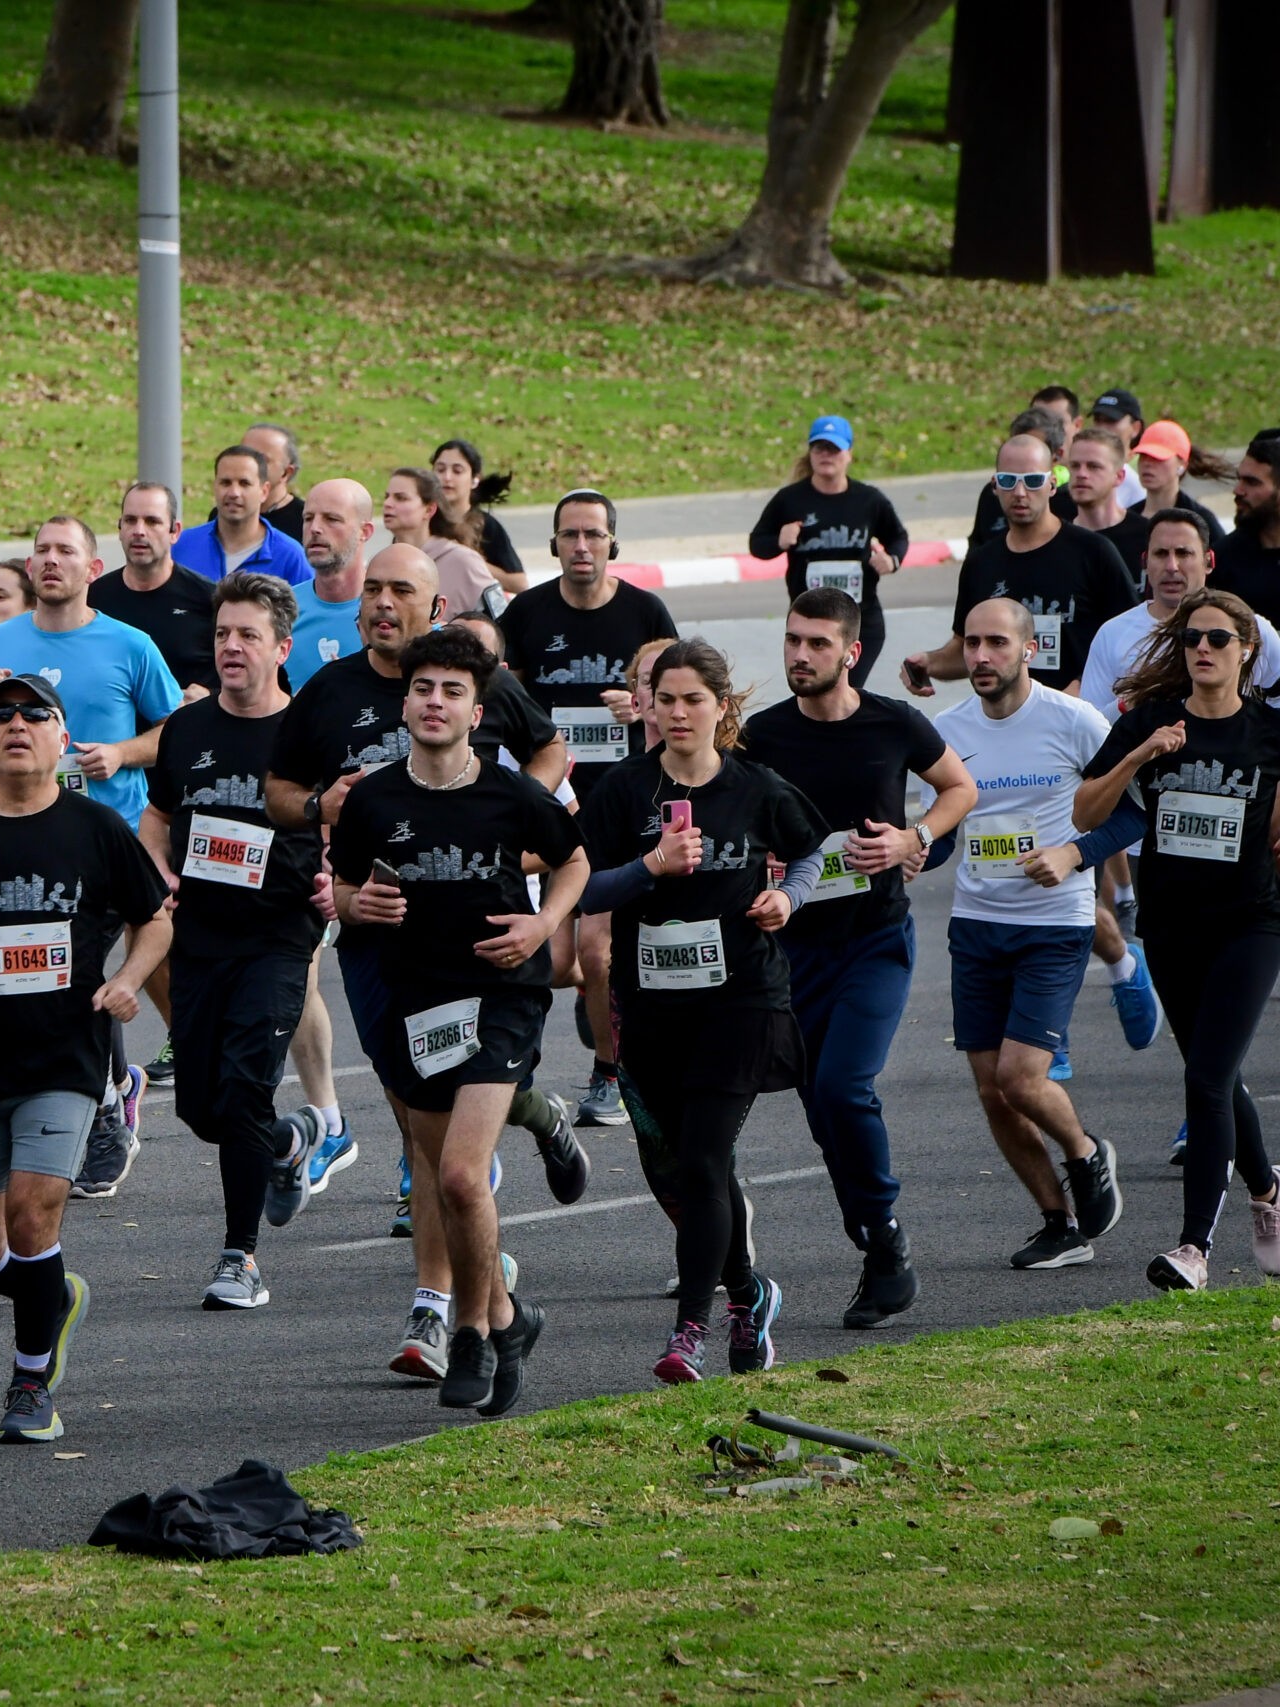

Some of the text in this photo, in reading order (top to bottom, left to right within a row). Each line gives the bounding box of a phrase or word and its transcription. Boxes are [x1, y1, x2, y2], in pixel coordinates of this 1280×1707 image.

[572, 726, 608, 743] 51319
[975, 774, 1062, 791] AreMobileye
[1178, 815, 1217, 837] 51751
[208, 840, 246, 863] 64495
[982, 838, 1016, 857] 40704
[4, 948, 48, 970] 61643
[656, 946, 699, 968] 52483
[427, 1024, 461, 1053] 52366
